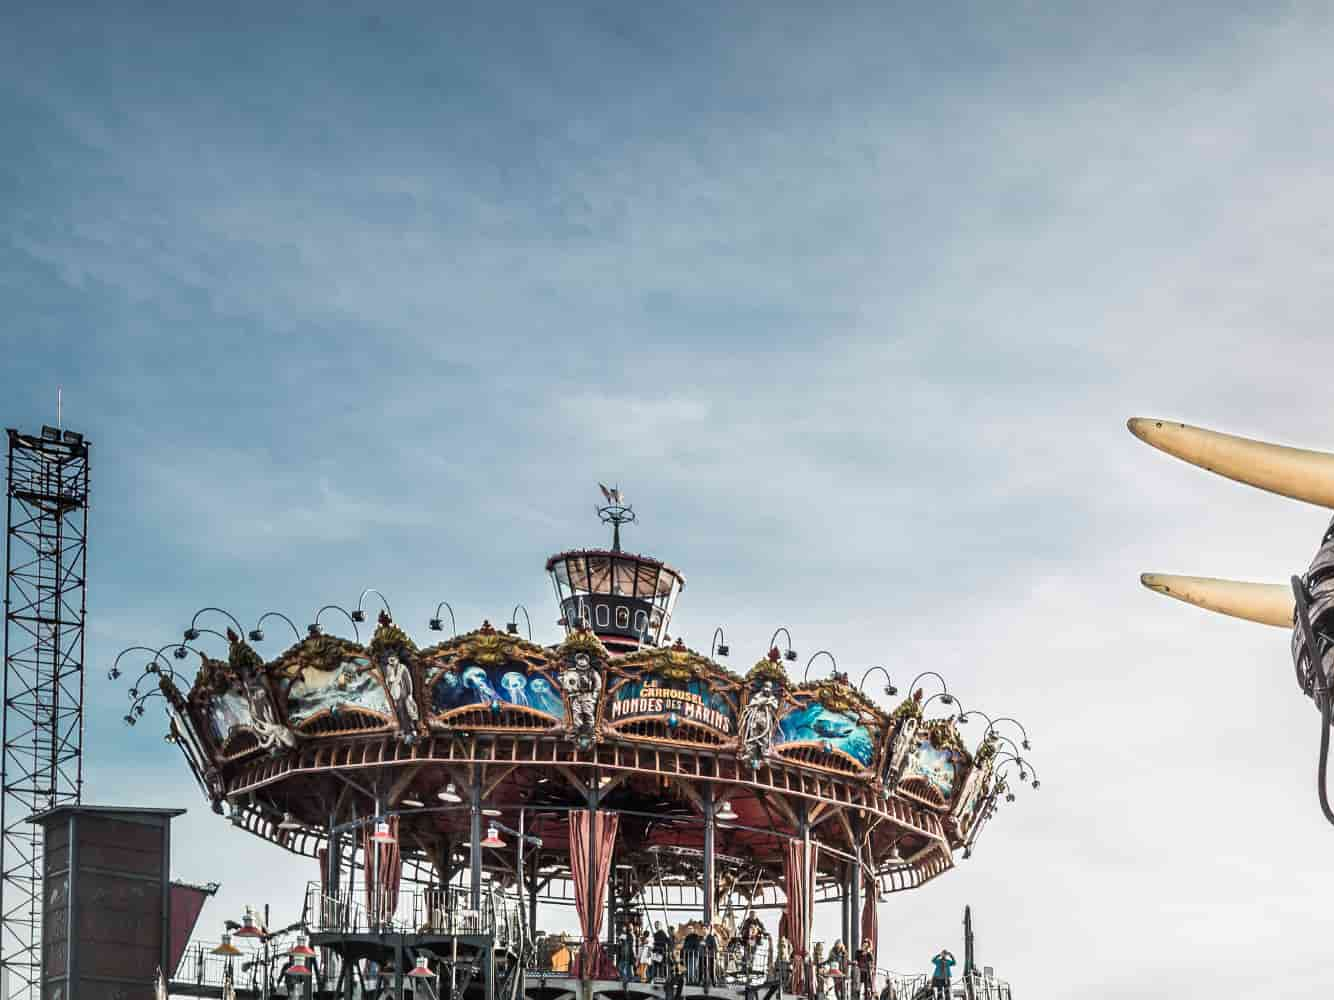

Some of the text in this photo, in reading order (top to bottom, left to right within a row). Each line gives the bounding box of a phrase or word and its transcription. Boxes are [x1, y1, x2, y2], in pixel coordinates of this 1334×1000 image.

[643, 680, 658, 688] LE
[640, 688, 704, 706] CARROUSEL
[612, 698, 730, 732] MONDES DES MARINS
